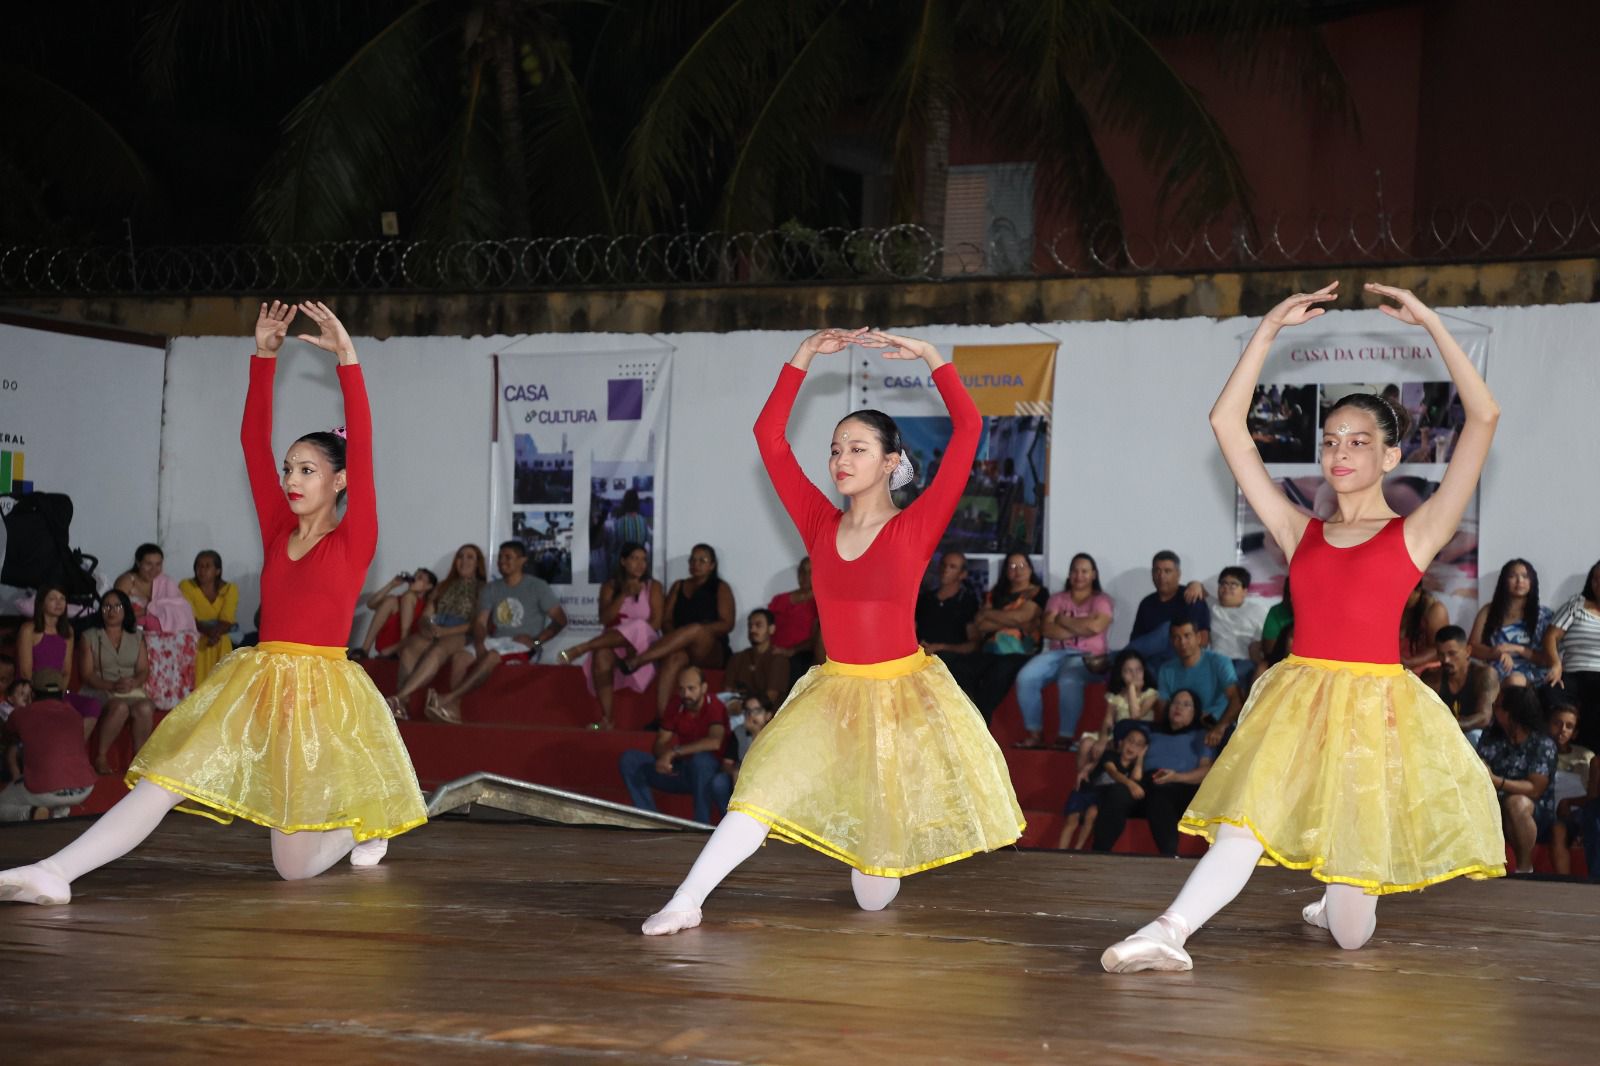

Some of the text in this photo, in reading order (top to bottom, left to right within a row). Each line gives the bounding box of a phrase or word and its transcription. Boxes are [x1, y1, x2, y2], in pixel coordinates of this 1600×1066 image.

[1291, 346, 1432, 362] CASA DA CULTURA
[884, 375, 923, 389] CASA
[961, 374, 1024, 388] ULTURA
[504, 384, 549, 402] CASA
[538, 409, 598, 425] CULTURA
